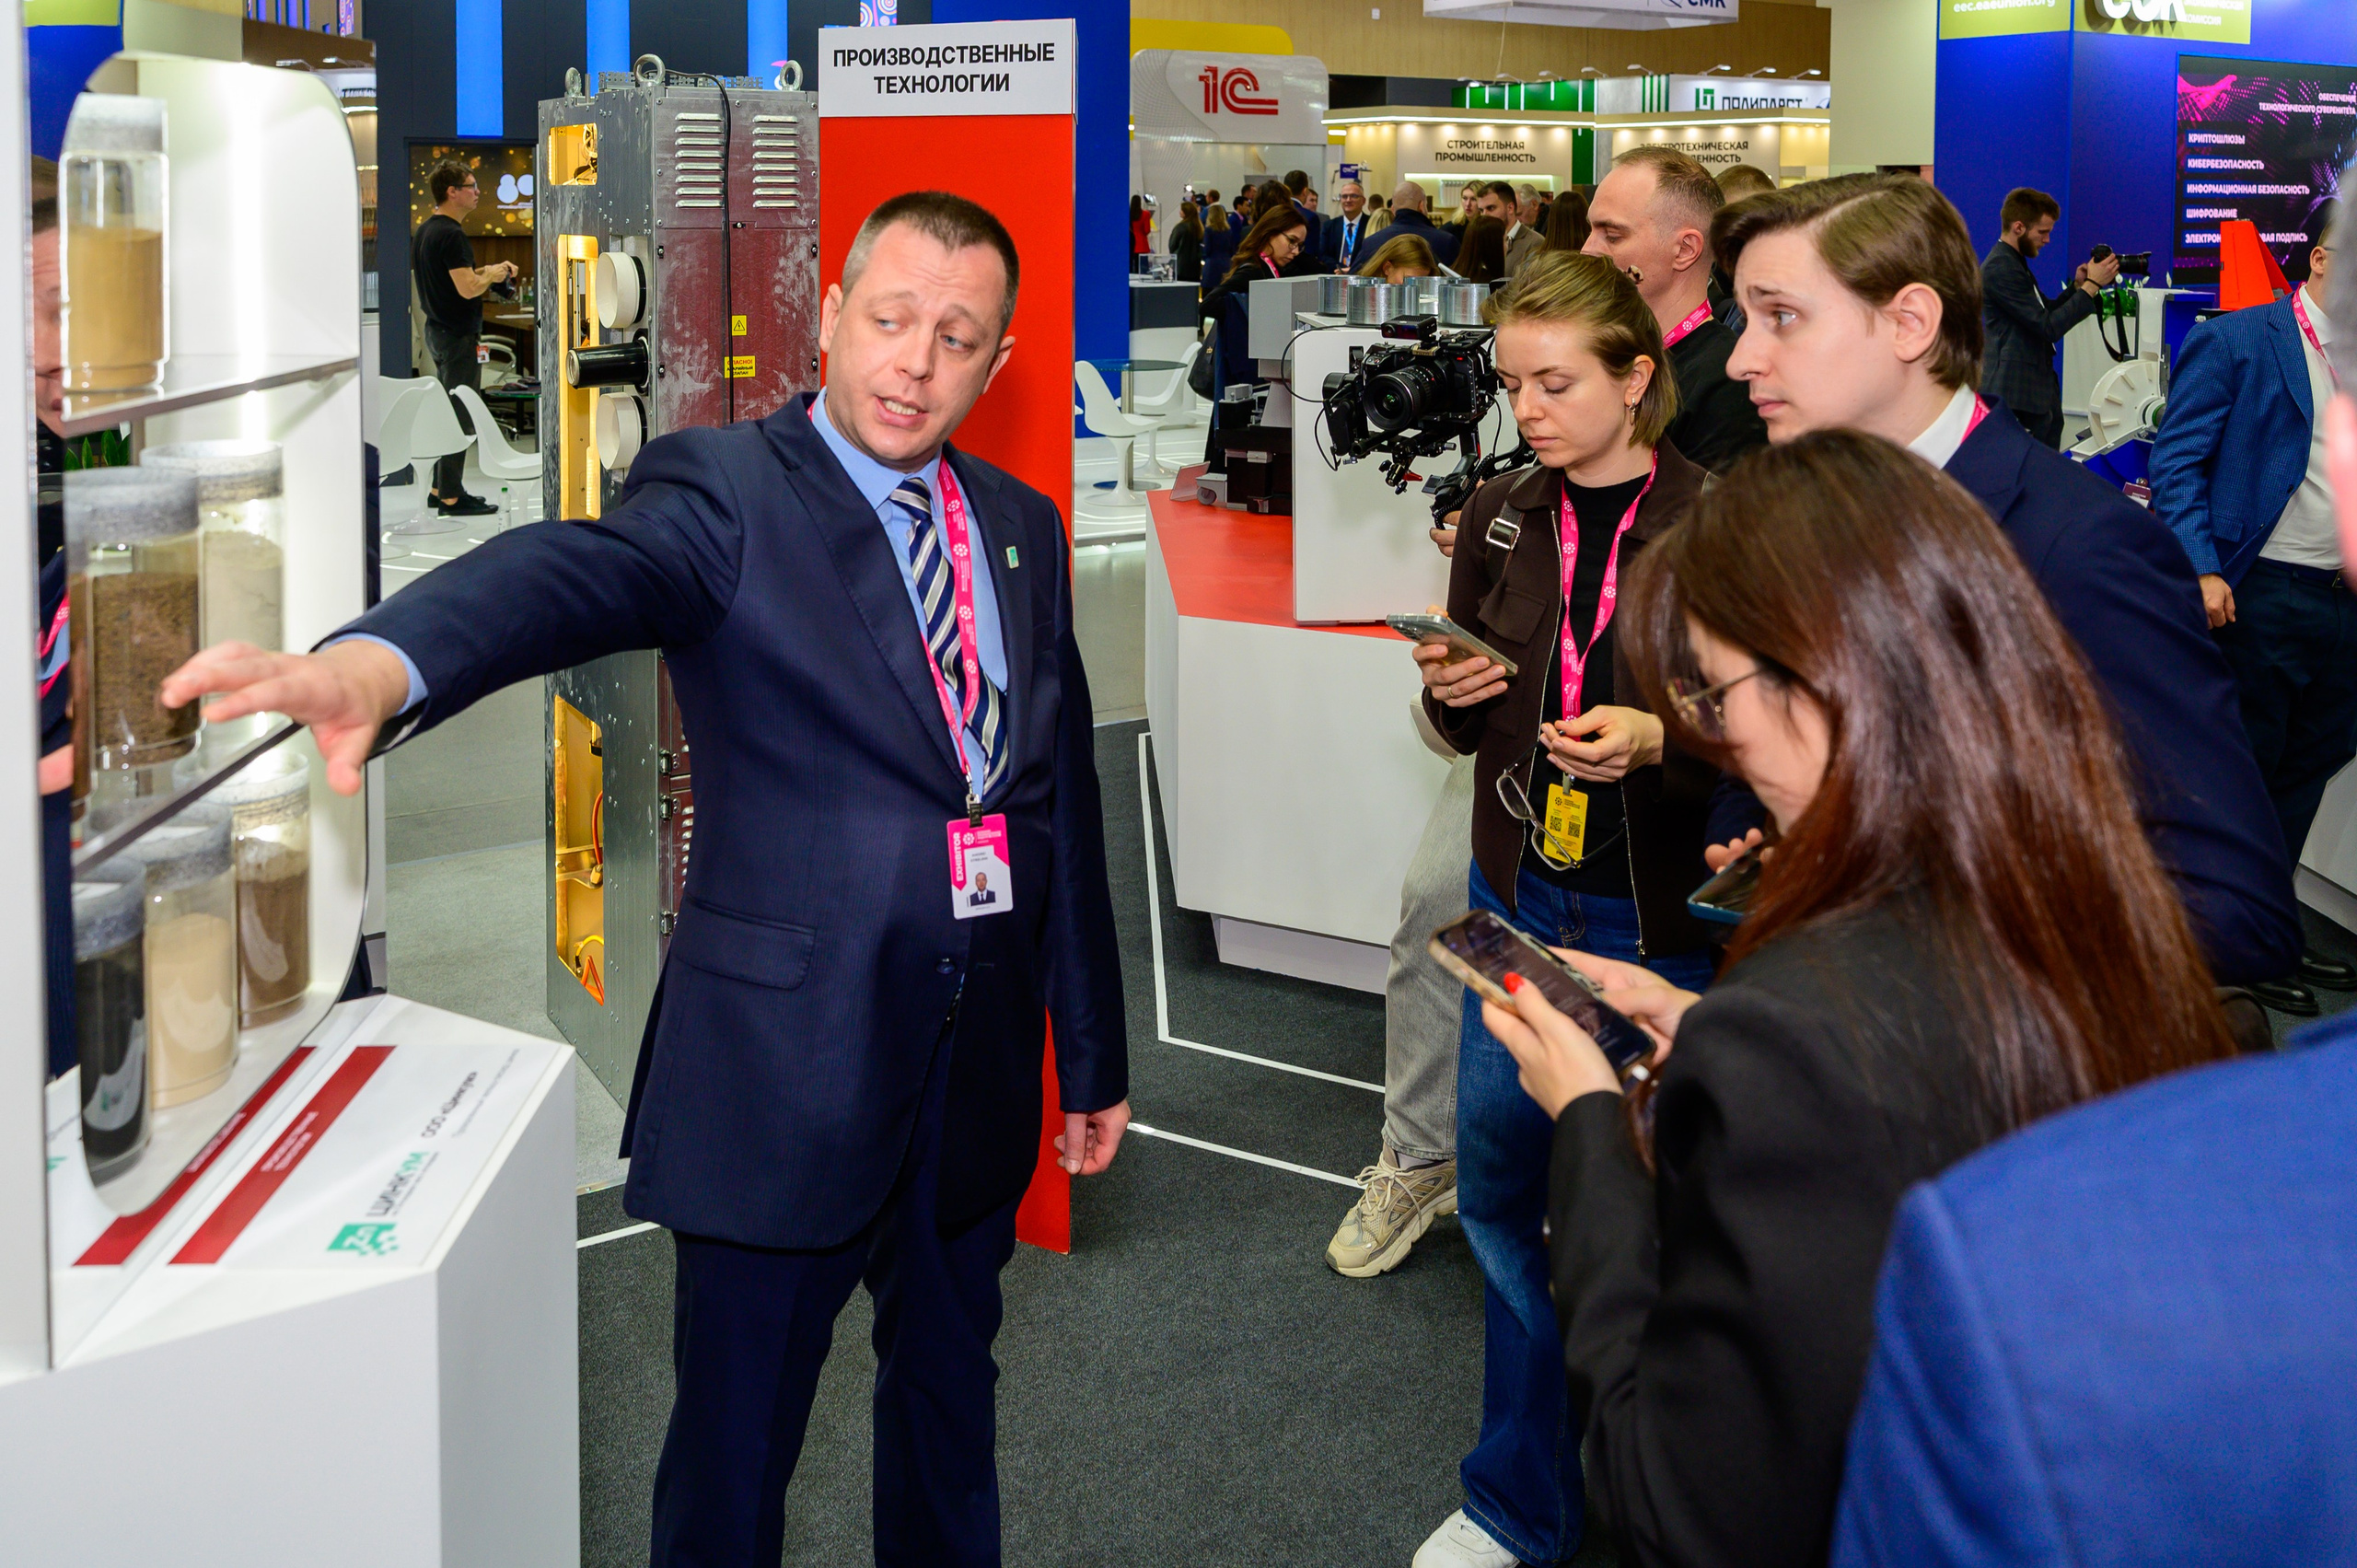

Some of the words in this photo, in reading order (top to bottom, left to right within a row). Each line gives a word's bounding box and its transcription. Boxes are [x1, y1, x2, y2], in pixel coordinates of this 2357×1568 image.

[833, 42, 1055, 68] ПРОИЗВОДСТВЕННЫЕ
[874, 73, 1010, 94] ТЕХНОЛОГИИ
[1446, 140, 1525, 150] СТРОИТЕЛЬНАЯ
[2188, 134, 2246, 145] КРИПТОШЛЮЗЫ
[1435, 152, 1537, 163] ПРОМЫШЛЕННОСТЬ
[2188, 158, 2265, 169] КИБЕРБЕЗОПАСНОСТЬ
[2187, 184, 2257, 195] ИНФОРМАЦИОННАЯ
[2258, 185, 2310, 195] БЕЗОПАСНОСТЬ
[2186, 208, 2237, 219] ШИФРОВАНИЕ
[2276, 233, 2308, 244] ПОДПИСЬ
